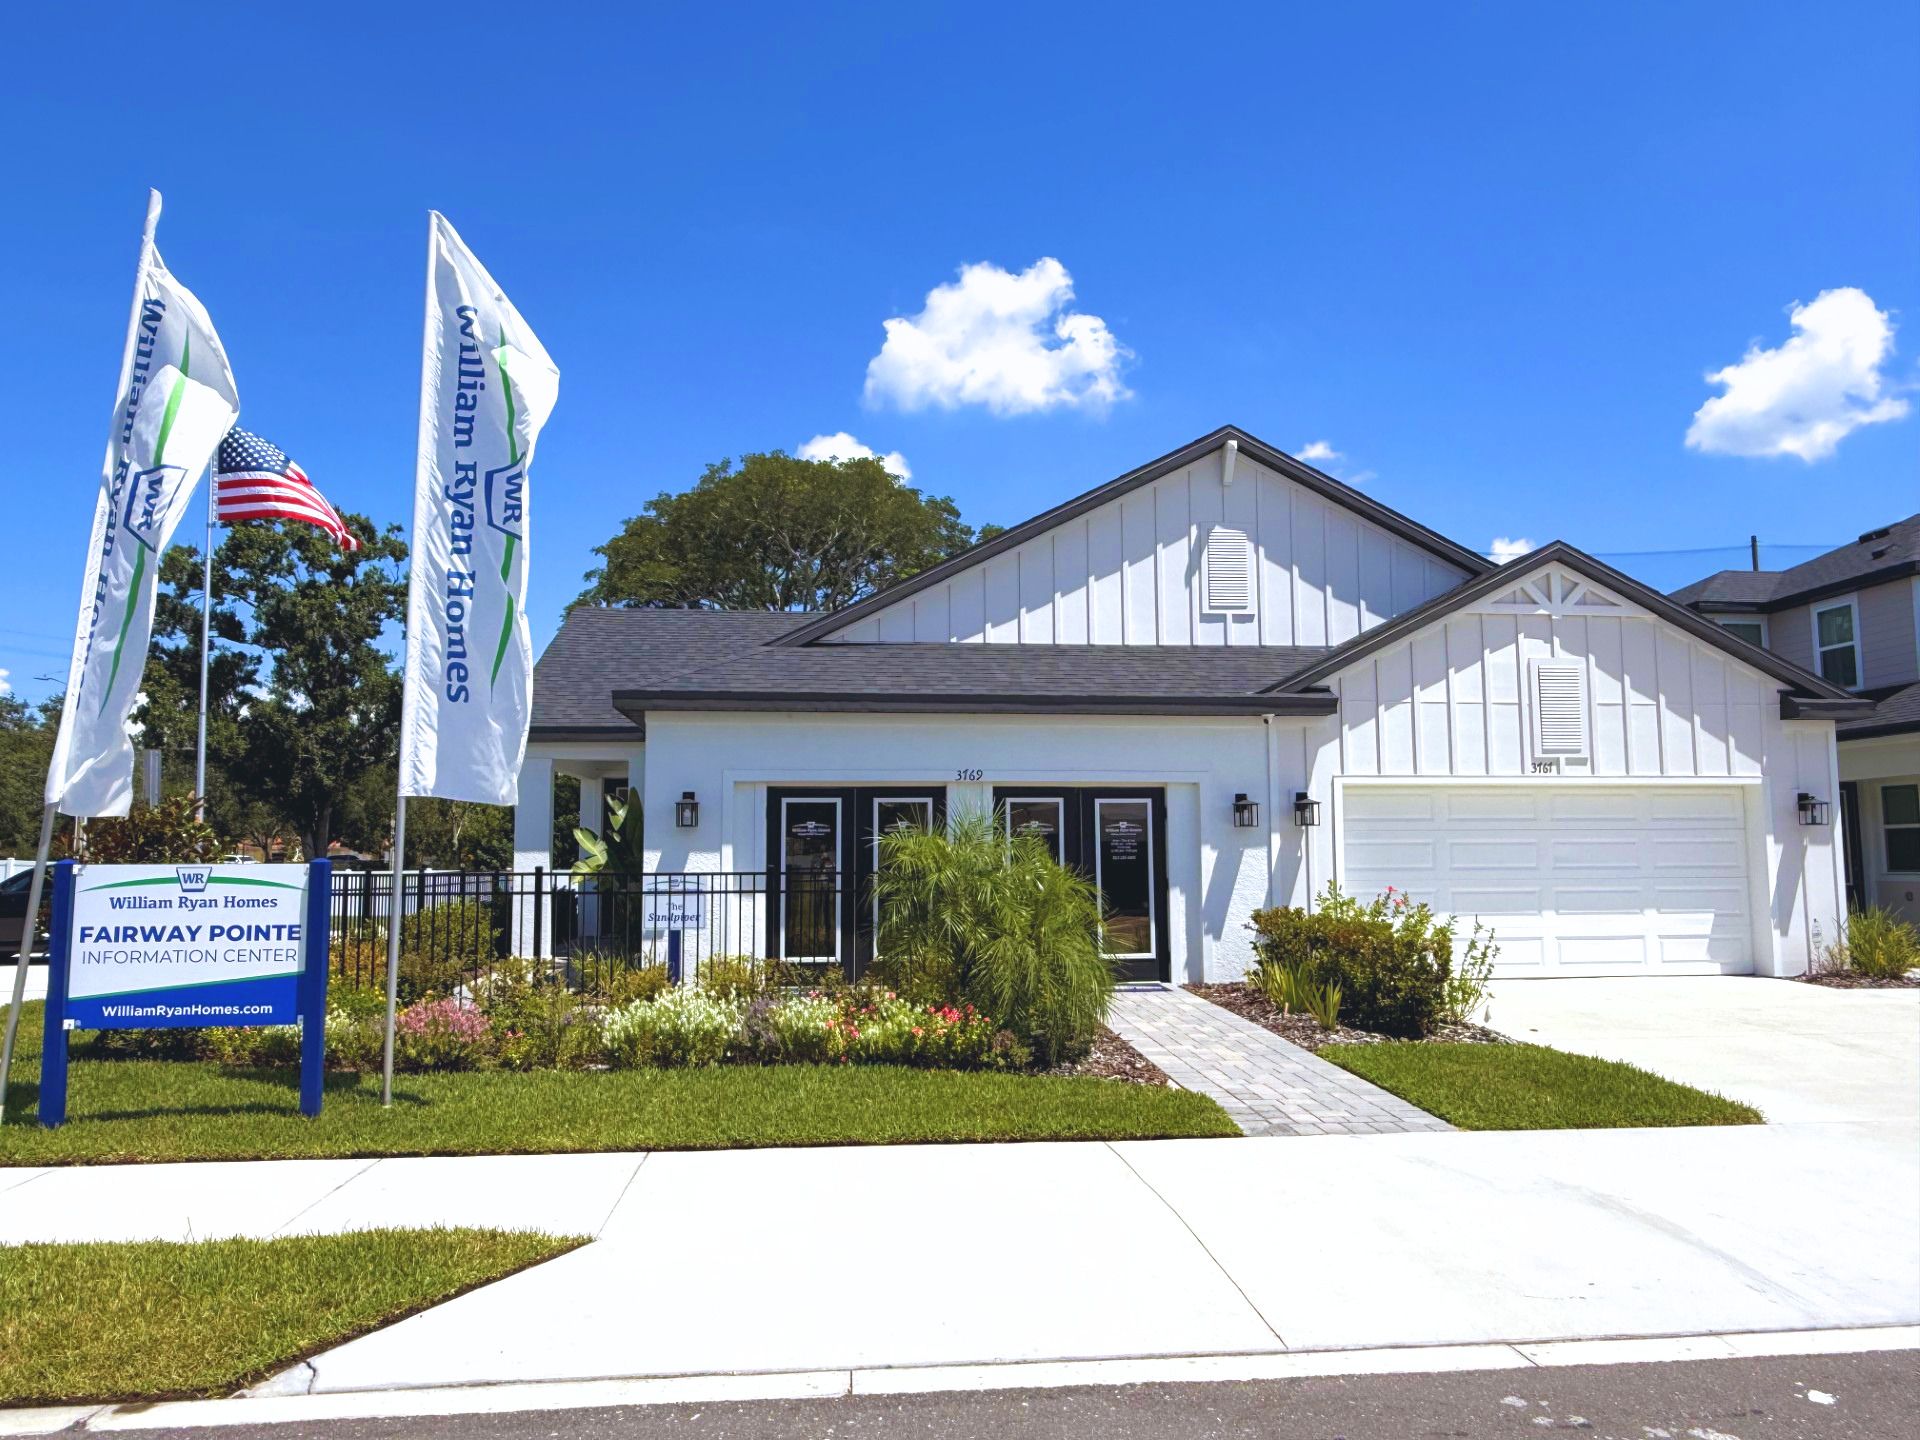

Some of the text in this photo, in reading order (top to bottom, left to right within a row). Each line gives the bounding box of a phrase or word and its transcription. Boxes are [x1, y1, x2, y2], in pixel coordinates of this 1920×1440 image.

[121, 298, 166, 445] William
[136, 474, 165, 531] WR
[444, 304, 486, 704] William Ryan Homes
[501, 470, 523, 526] WR
[182, 872, 205, 885] WR
[109, 895, 278, 912] William Ryan Homes
[79, 924, 302, 944] FAIRWAY POINTE
[81, 948, 297, 965] INFORMATION CENTER
[101, 1003, 273, 1018] WilliamRyanHomes.com
